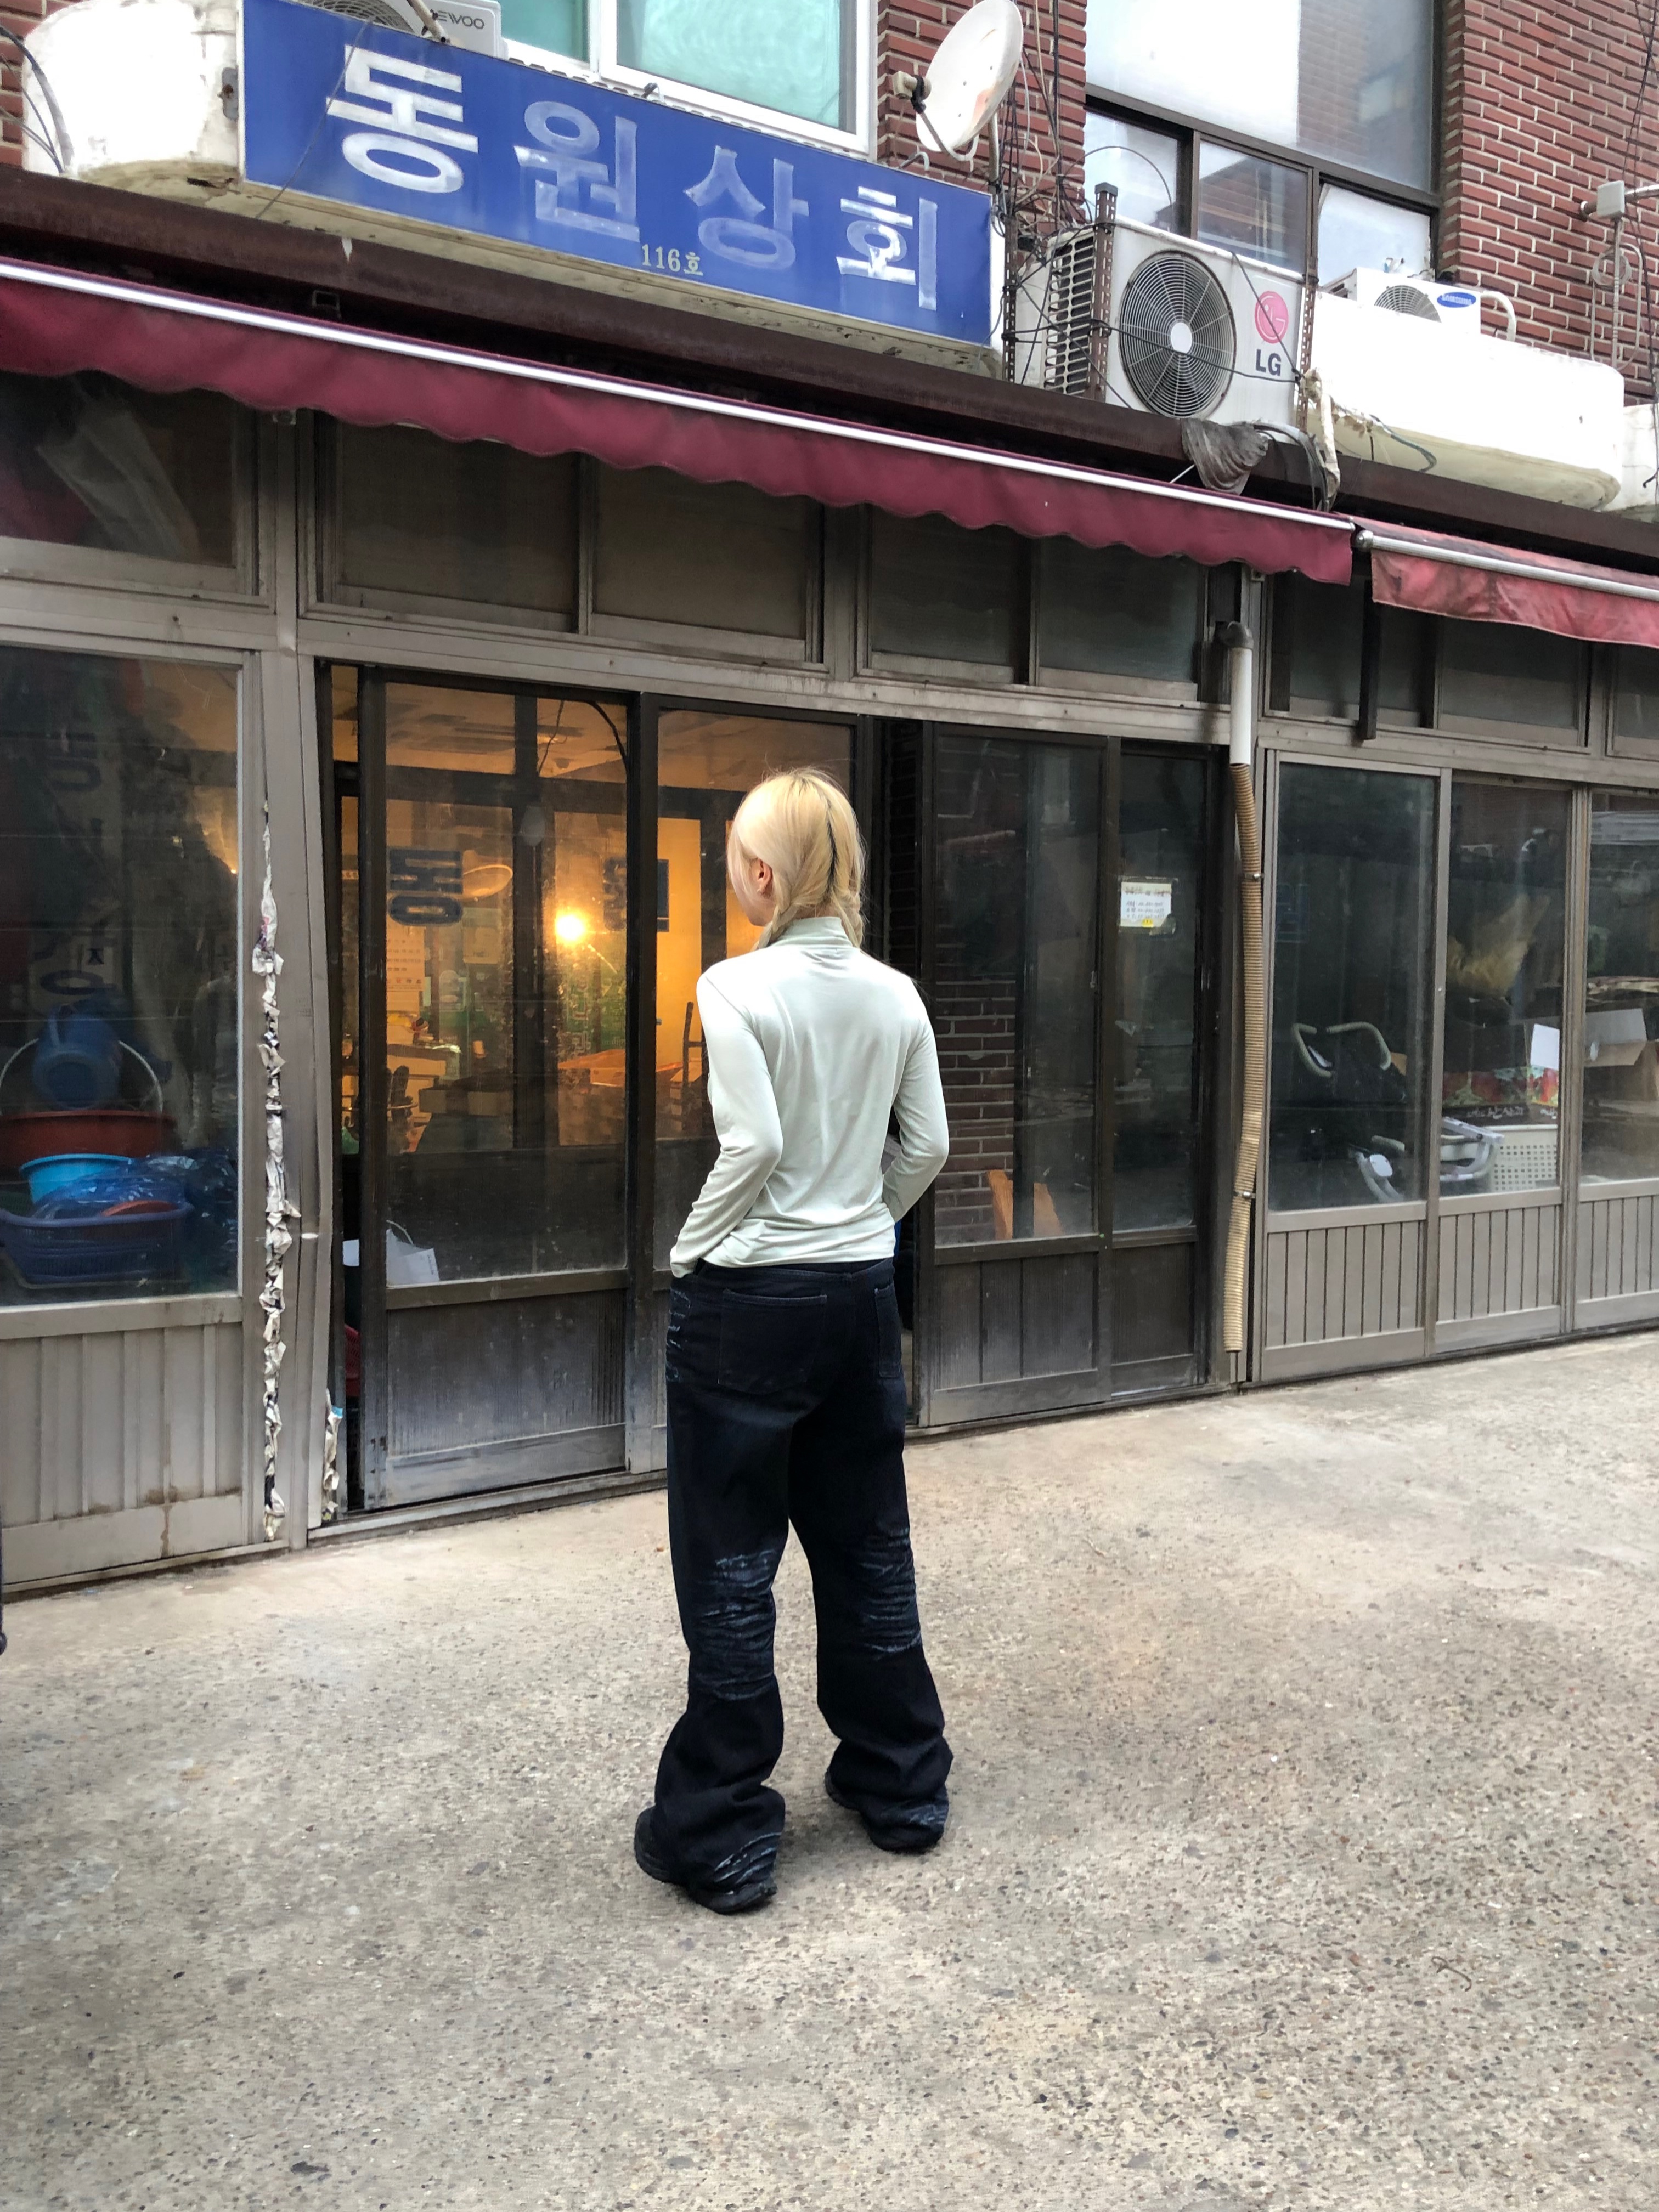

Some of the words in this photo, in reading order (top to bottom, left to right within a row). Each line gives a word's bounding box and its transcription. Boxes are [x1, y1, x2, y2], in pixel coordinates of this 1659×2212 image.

[326, 44, 939, 312] 동원상회
[641, 244, 704, 276] 116호
[1255, 349, 1282, 376] LG
